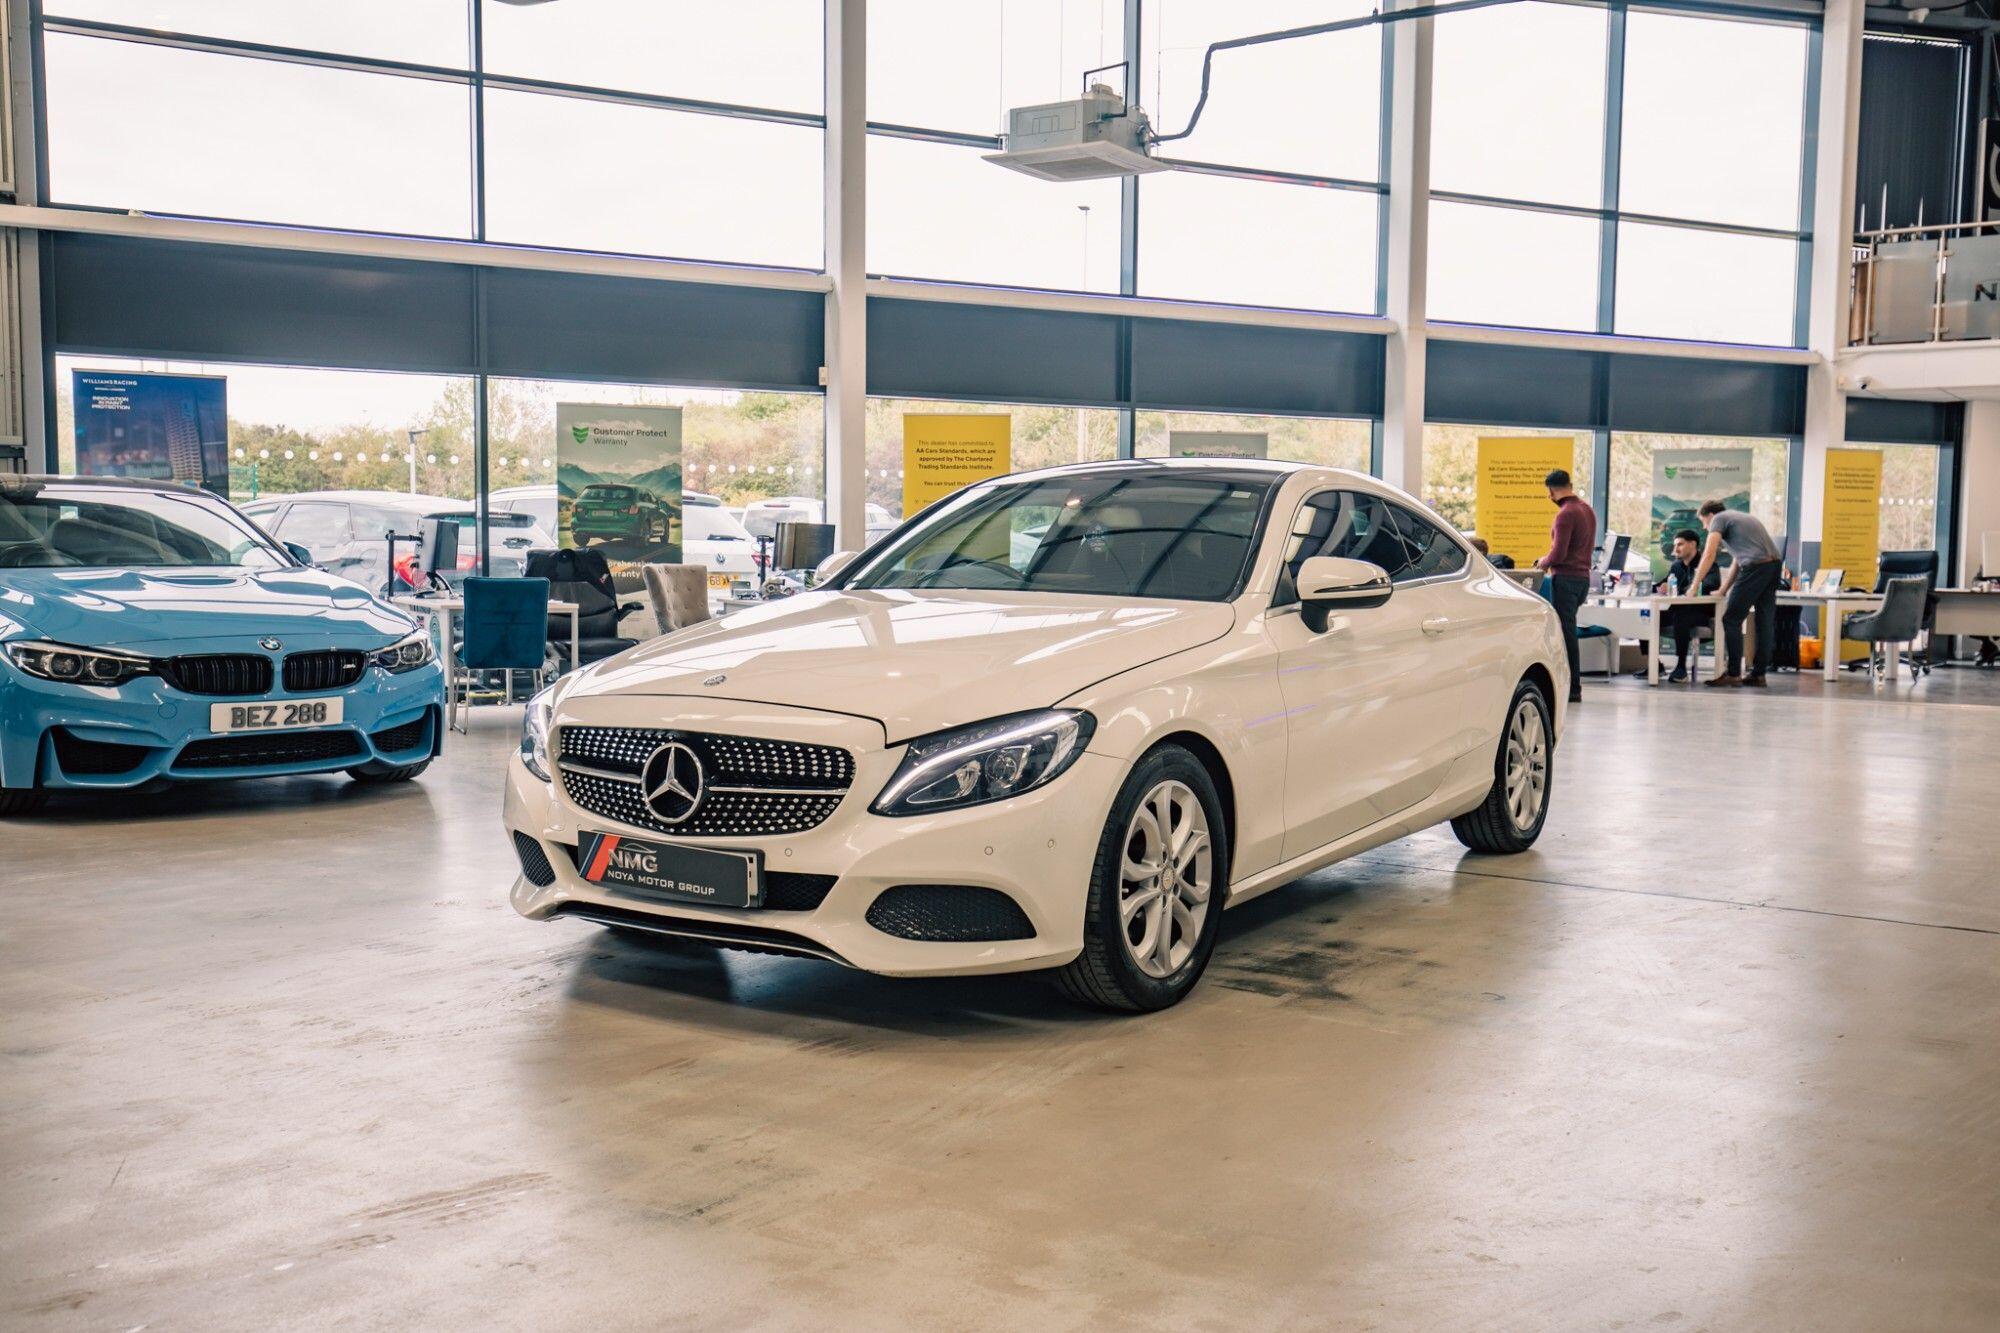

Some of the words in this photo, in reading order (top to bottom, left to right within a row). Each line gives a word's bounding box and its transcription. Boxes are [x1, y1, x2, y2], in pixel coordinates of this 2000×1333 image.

[593, 427, 634, 437] Customer
[636, 429, 667, 438] Protect
[593, 438, 628, 446] Warranty
[231, 705, 278, 729] BEZ
[284, 702, 327, 726] 288
[608, 849, 658, 873] NMG
[607, 869, 634, 882] NOYA
[638, 877, 675, 889] MOTOR
[678, 882, 716, 896] GROUP
